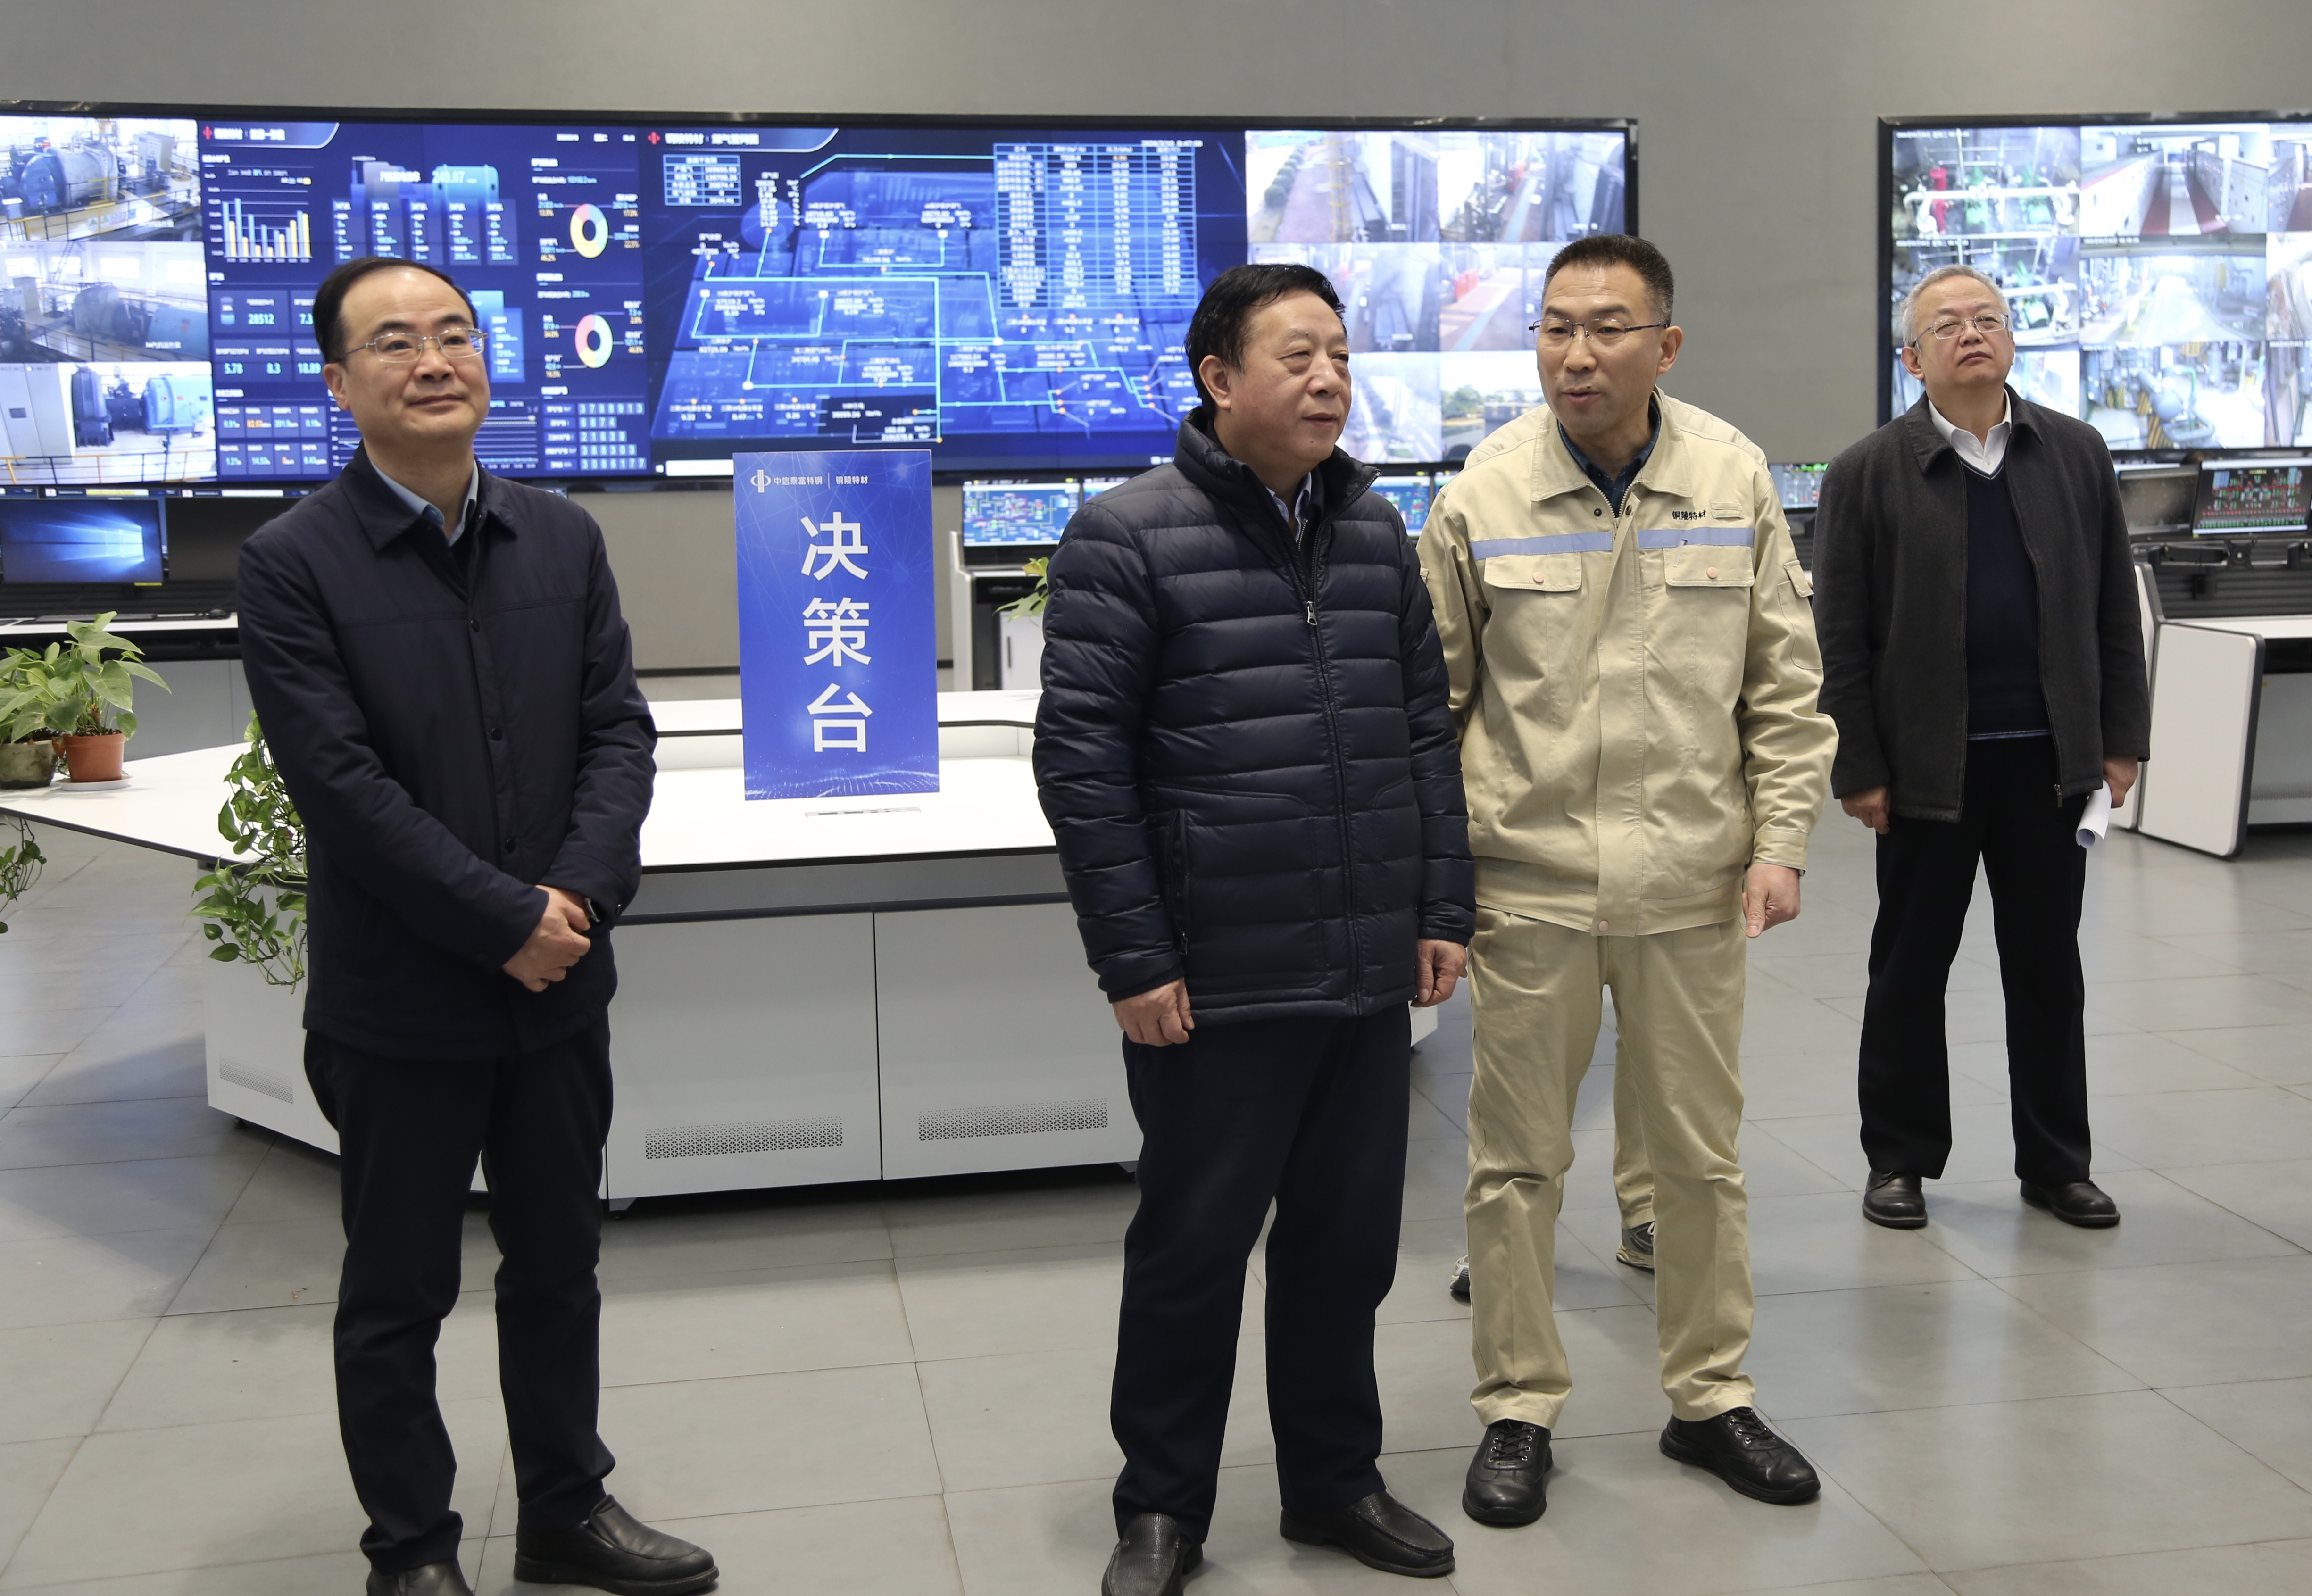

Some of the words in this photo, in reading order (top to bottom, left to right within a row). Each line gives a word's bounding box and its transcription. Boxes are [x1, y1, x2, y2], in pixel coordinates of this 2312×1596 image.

[773, 476, 823, 485] 中信泰富特钢
[835, 475, 869, 485] 铜陵特材
[1672, 510, 1707, 520] 铜陵特材
[800, 511, 873, 753] 决策台
